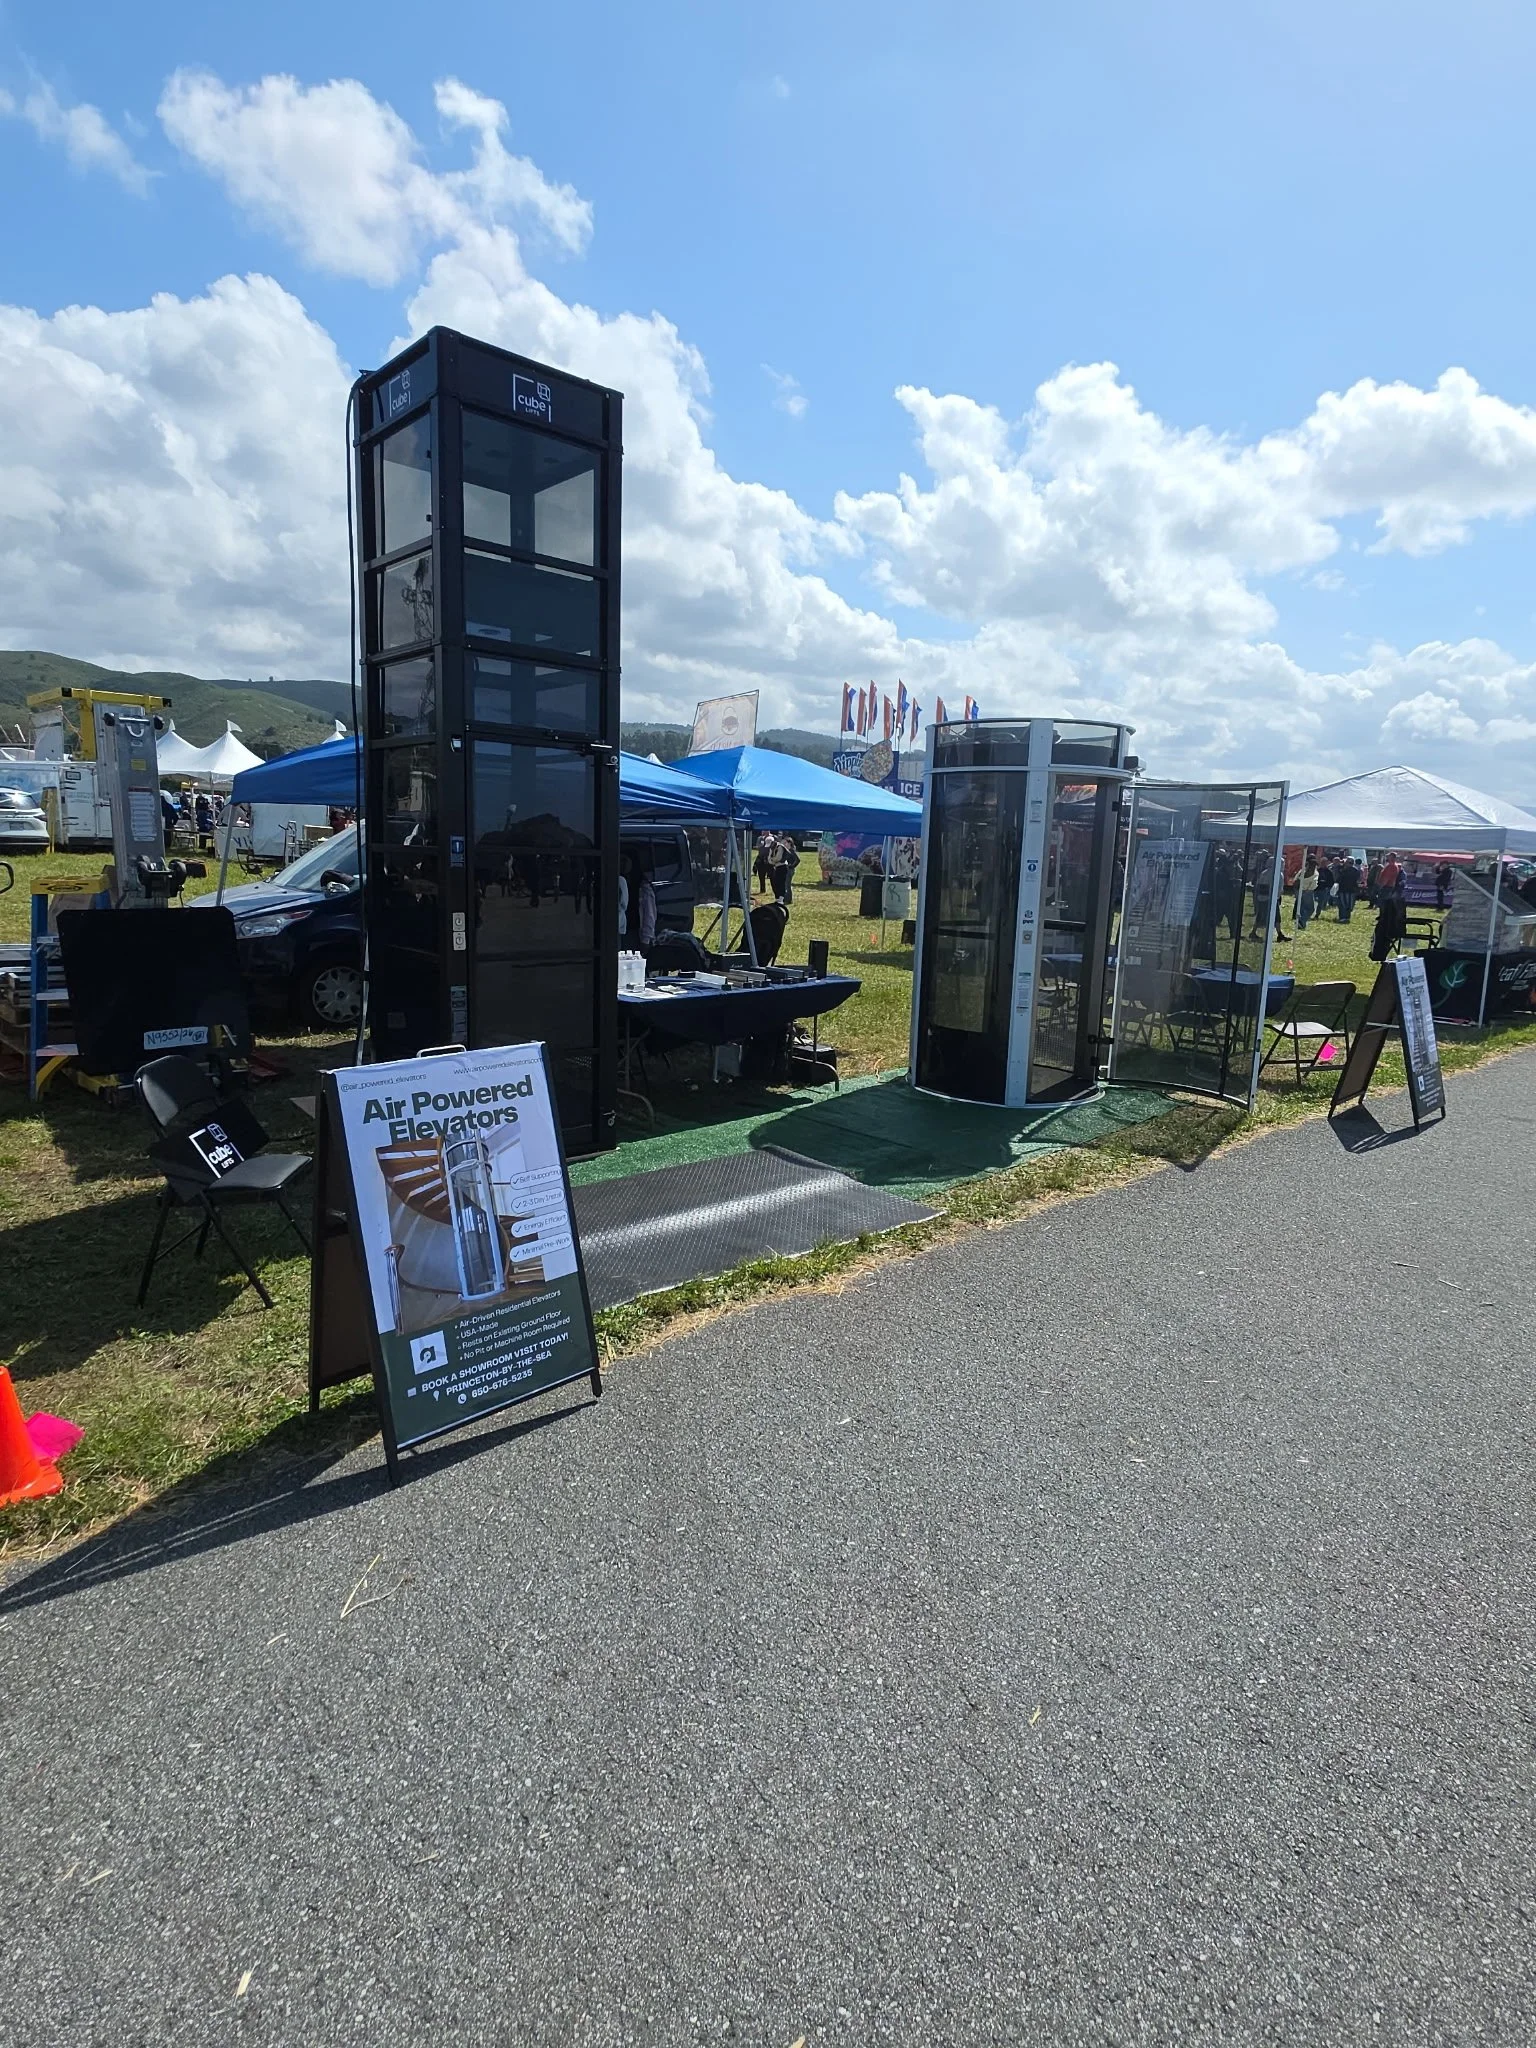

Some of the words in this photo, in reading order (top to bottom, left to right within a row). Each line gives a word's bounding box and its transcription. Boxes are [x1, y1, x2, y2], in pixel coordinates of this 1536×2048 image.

[392, 392, 408, 410] cube
[517, 394, 547, 412] cube
[900, 782, 921, 796] ICE
[340, 1073, 428, 1093] @air_powered_elevators
[362, 1096, 407, 1125] Air
[411, 1074, 534, 1116] Powered
[388, 1105, 519, 1146] Elevators
[208, 1144, 234, 1165] cube
[522, 1198, 534, 1208] 2-3
[534, 1197, 545, 1206] Day
[545, 1191, 563, 1201] Install
[523, 1220, 544, 1231] Energy
[544, 1214, 566, 1225] Efficient
[521, 1244, 544, 1256] Minimal
[543, 1236, 570, 1250] Pre-Work
[459, 1311, 495, 1329] Air-Driven
[495, 1298, 532, 1316] Residential
[531, 1289, 561, 1305] Elevators
[460, 1321, 499, 1340] USA-Made
[462, 1338, 483, 1350] Rests
[483, 1333, 493, 1342] on
[493, 1323, 521, 1339] Existing
[520, 1315, 545, 1330] Ground
[545, 1310, 562, 1321] Floor
[463, 1349, 475, 1361] No
[474, 1347, 486, 1357] Pit
[485, 1344, 494, 1353] or
[494, 1334, 523, 1349] Machine
[523, 1327, 543, 1339] Room
[542, 1315, 571, 1333] Required
[421, 1376, 449, 1393] BOOK
[450, 1372, 458, 1382] A
[459, 1353, 514, 1379] SHOWROOM
[513, 1344, 538, 1359] VISIT
[538, 1331, 569, 1349] TODAY!
[446, 1350, 552, 1396] PRINCETON-BY-THE-SEA
[471, 1368, 533, 1399] 650-676-5235
